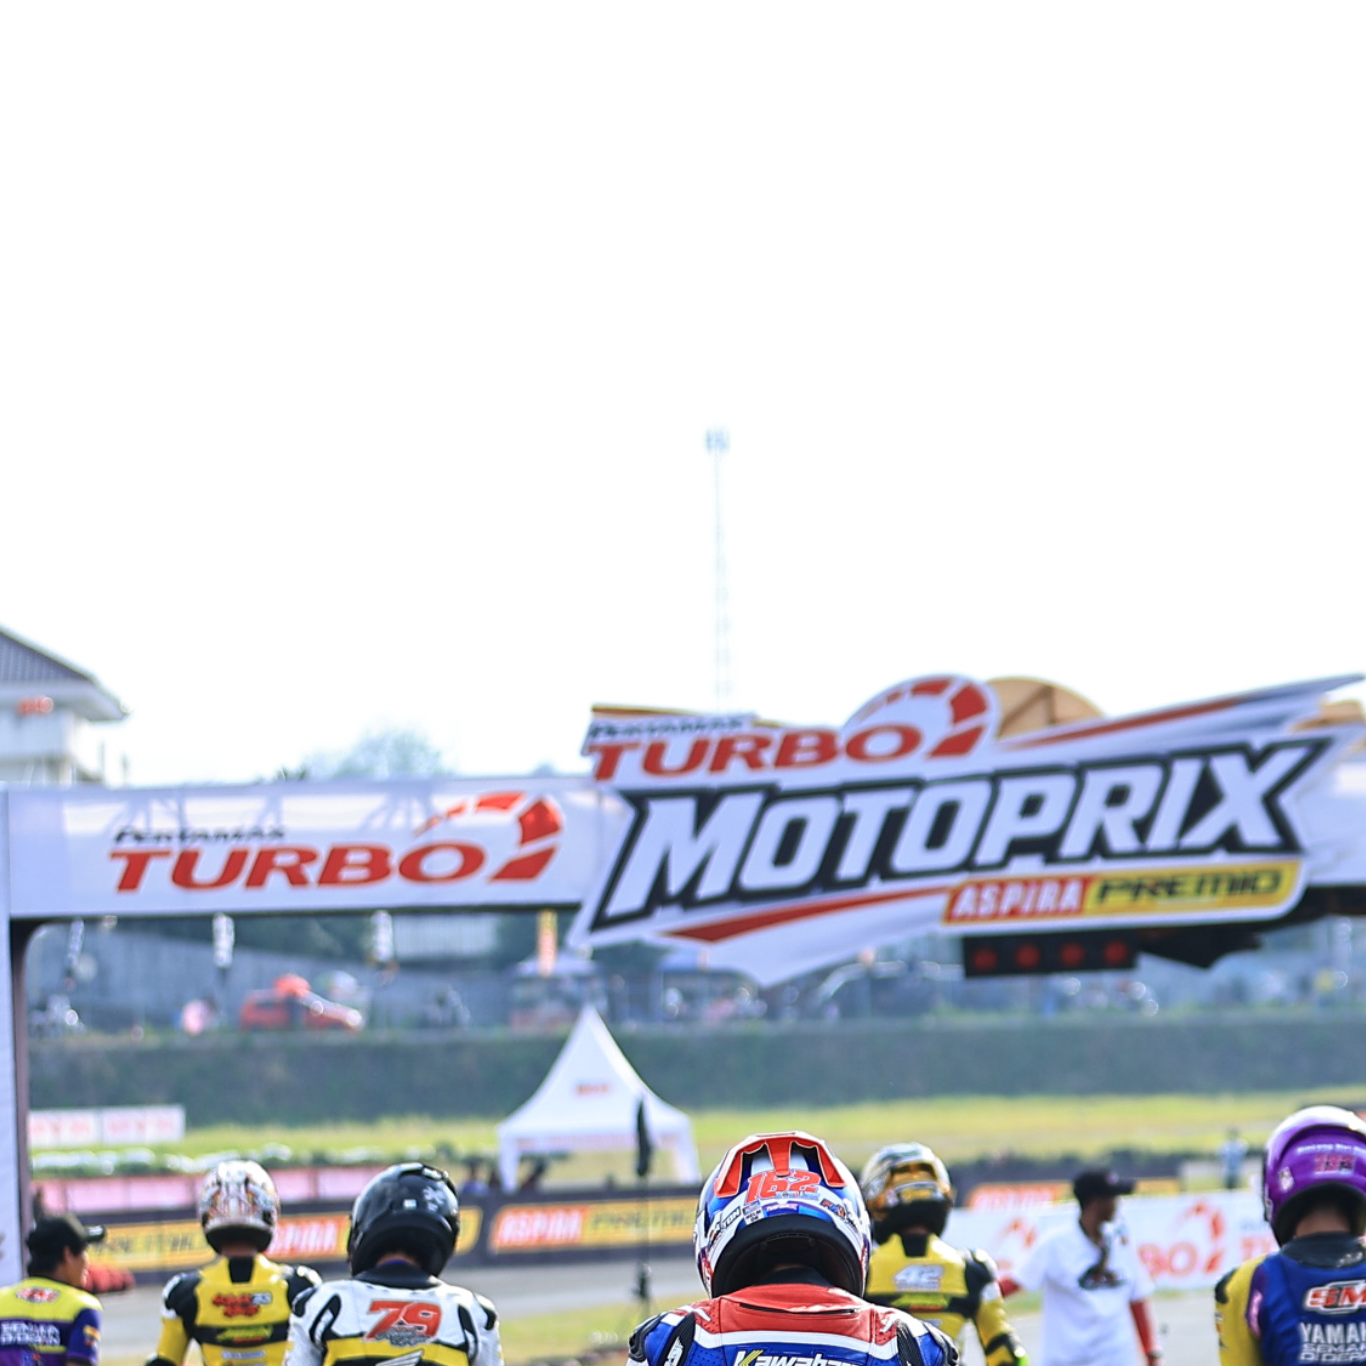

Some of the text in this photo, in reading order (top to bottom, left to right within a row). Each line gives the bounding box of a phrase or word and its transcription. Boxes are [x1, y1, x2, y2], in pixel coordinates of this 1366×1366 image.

[588, 722, 923, 781] TURBO
[604, 738, 1332, 918] MOTOPRIX
[110, 841, 487, 893] TURBO
[953, 864, 1281, 921] ASPIRA PREMIO
[364, 1300, 443, 1341] 79
